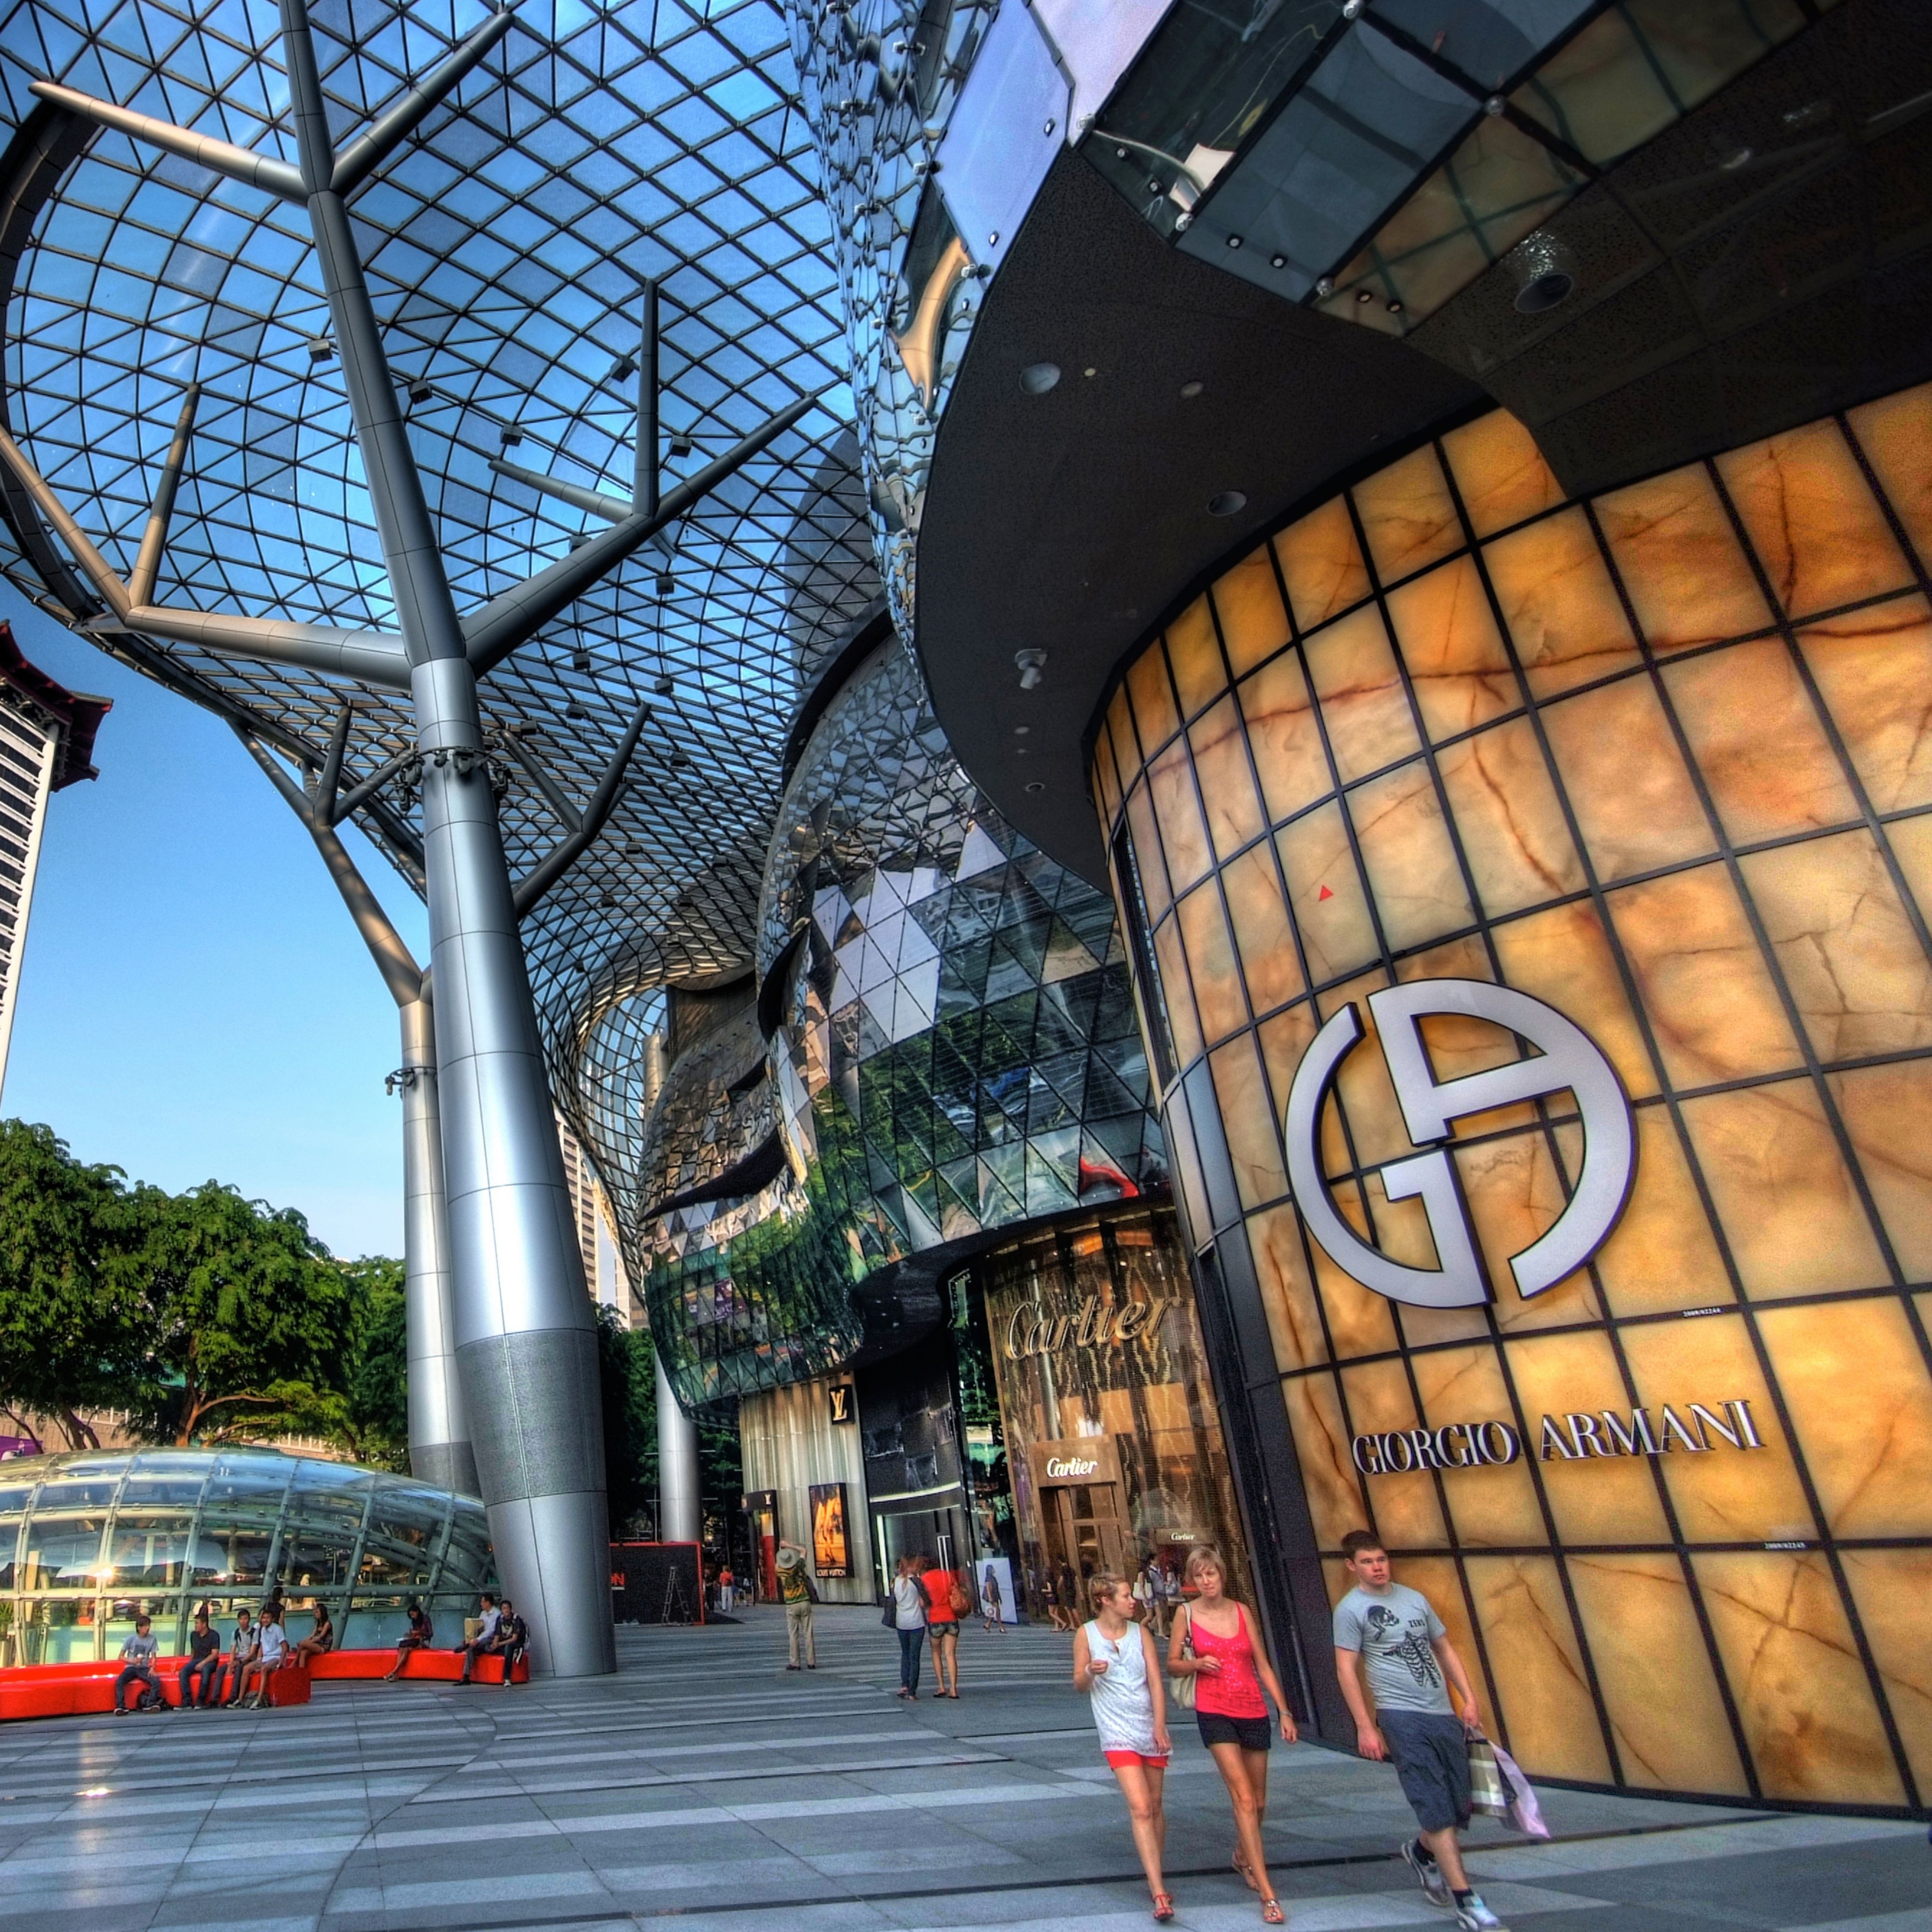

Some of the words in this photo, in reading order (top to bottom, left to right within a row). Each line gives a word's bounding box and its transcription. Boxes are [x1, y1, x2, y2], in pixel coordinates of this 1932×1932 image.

[1005, 1295, 1181, 1360] Cartier
[1047, 1457, 1097, 1477] Cartier
[1353, 1421, 1520, 1475] GIORGIO
[1537, 1400, 1764, 1461] ARMANI
